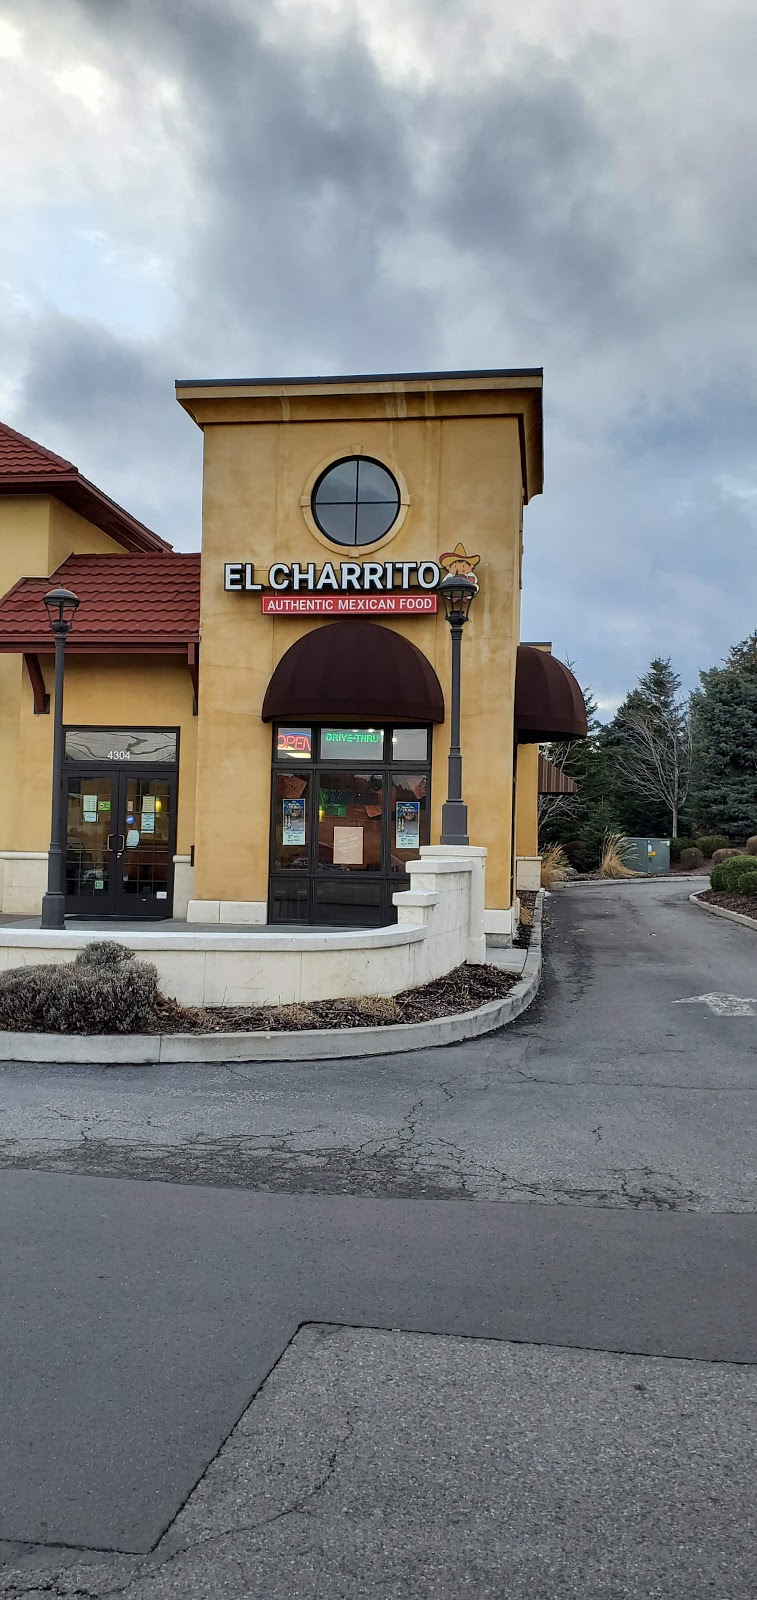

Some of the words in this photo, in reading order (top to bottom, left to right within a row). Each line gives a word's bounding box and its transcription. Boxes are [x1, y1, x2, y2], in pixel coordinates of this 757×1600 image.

[224, 563, 262, 591] EL
[268, 562, 440, 590] CHARRITO
[267, 599, 334, 611] AUTHENTIC
[338, 599, 396, 610] MEXICAN
[399, 598, 433, 609] FOOD
[277, 735, 311, 751] OPEN
[325, 733, 380, 743] DRIVE-THRU
[107, 750, 131, 760] 4304
